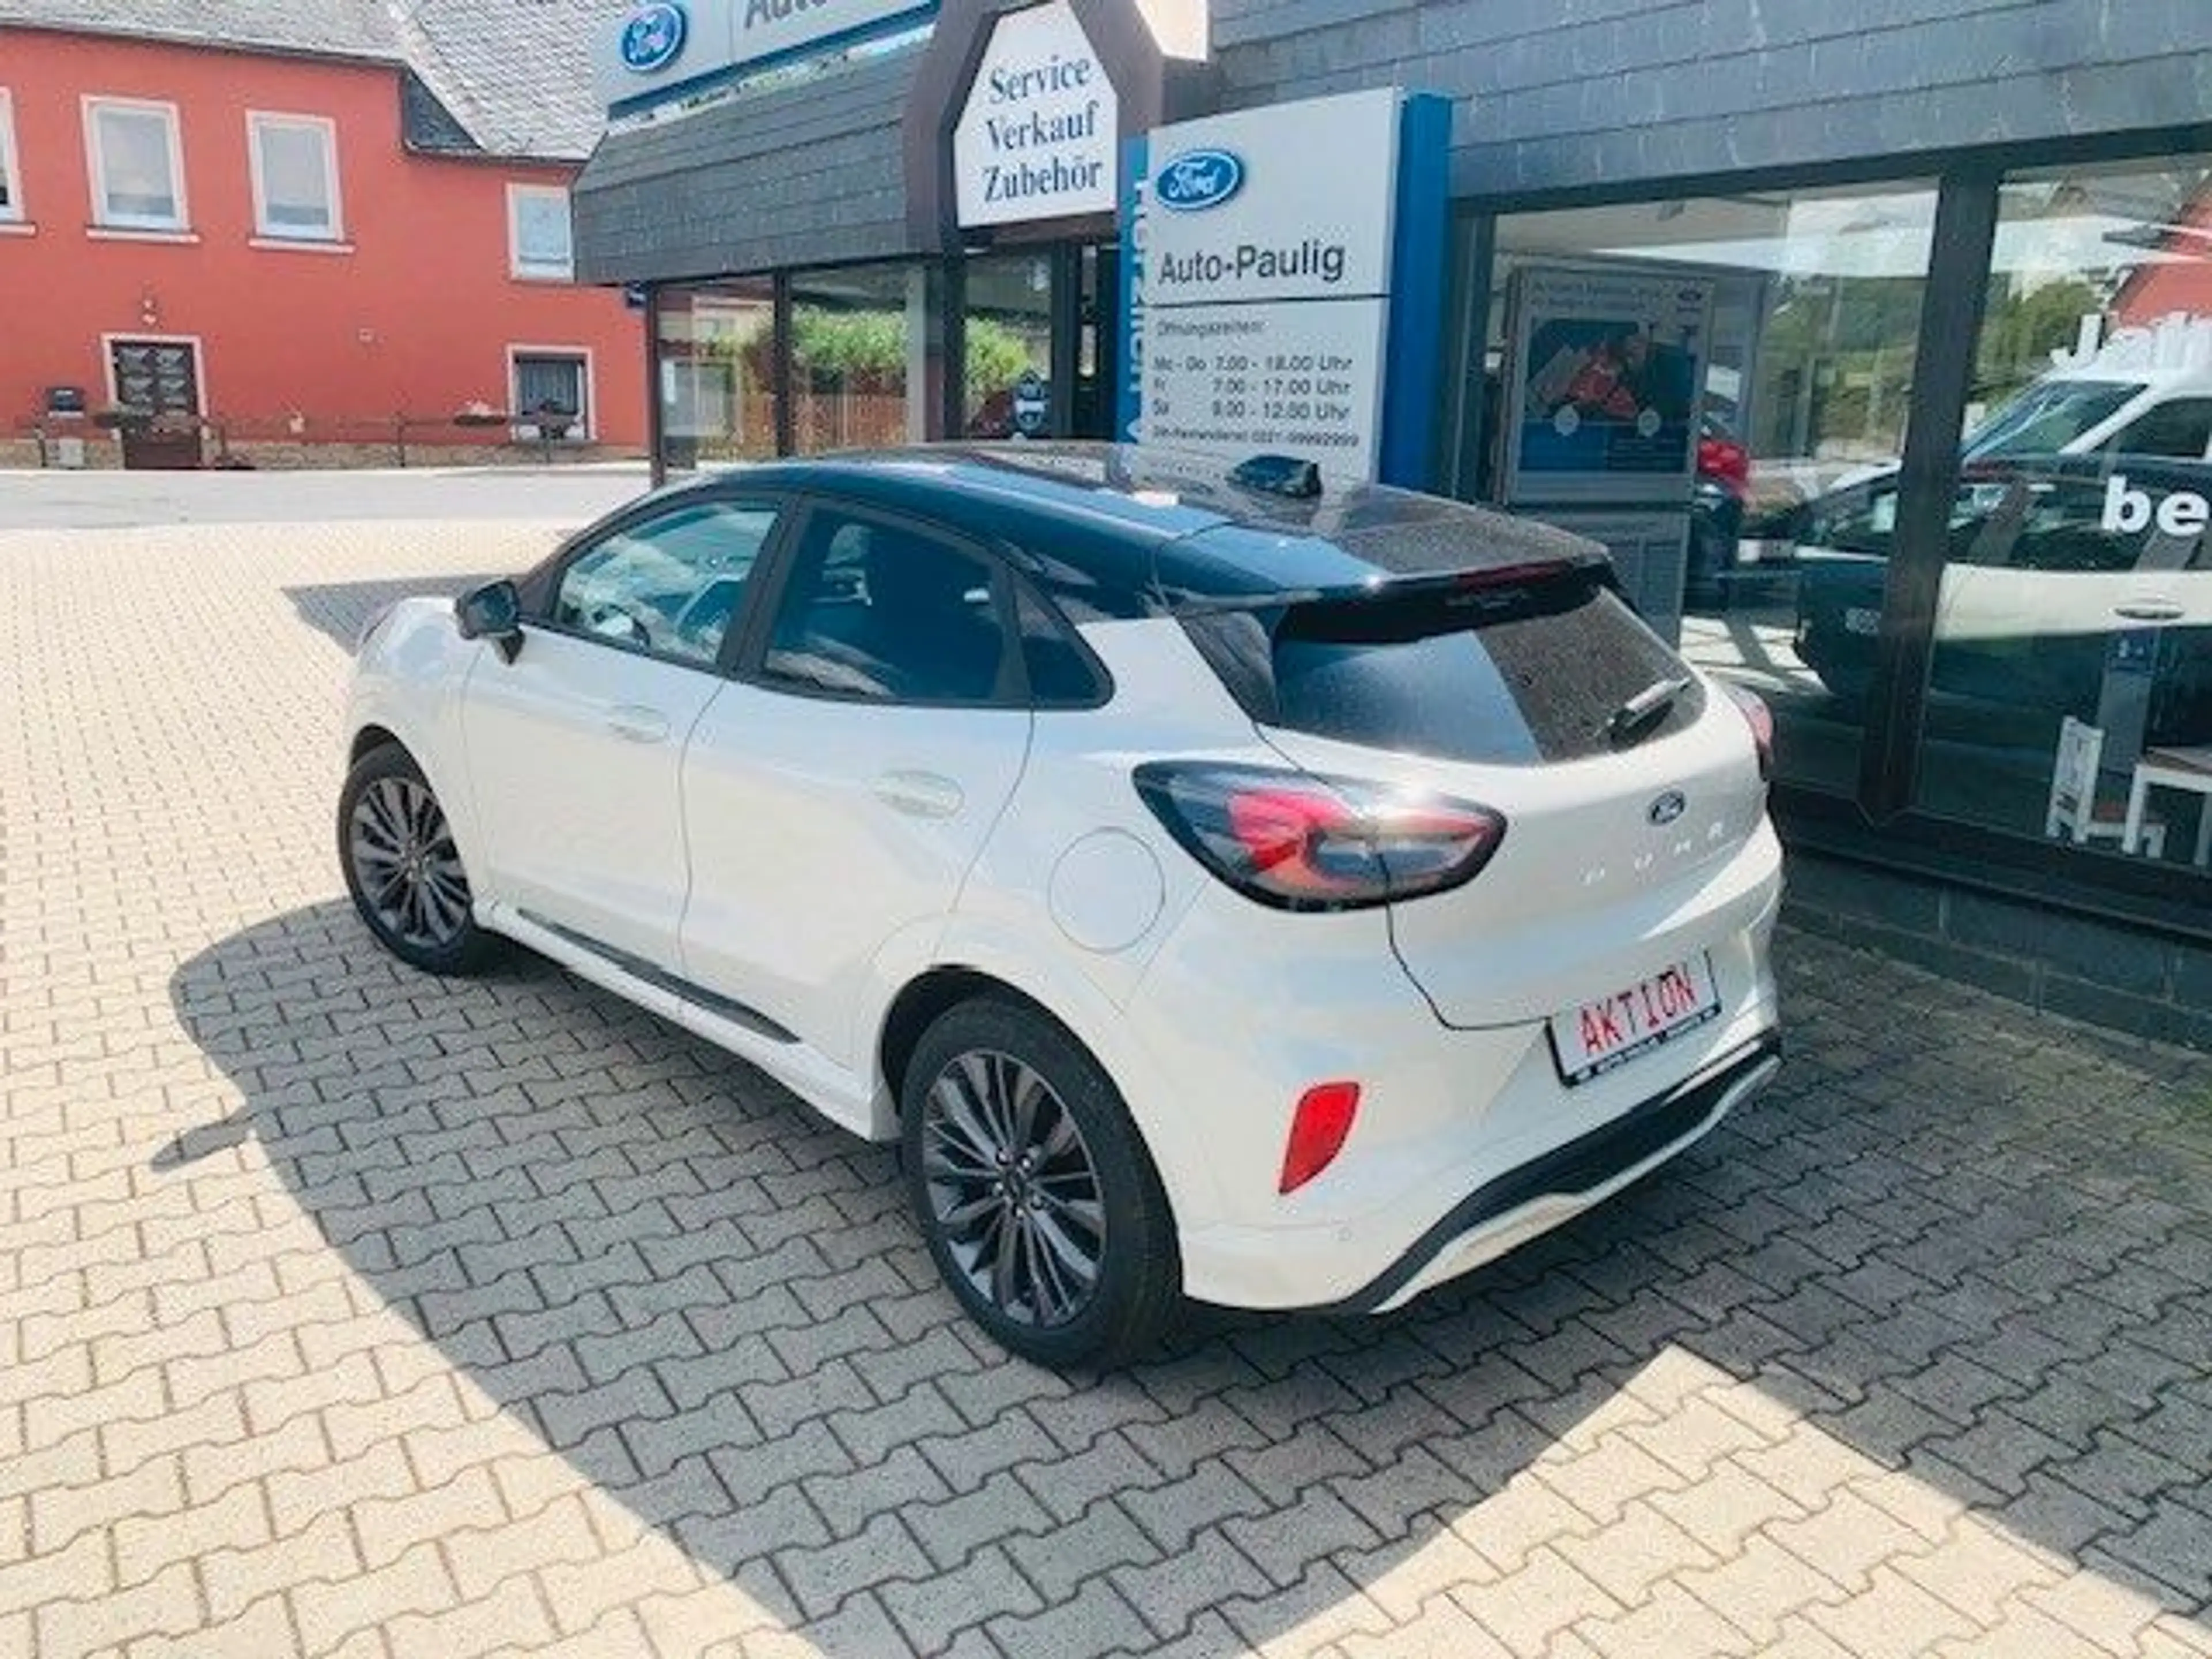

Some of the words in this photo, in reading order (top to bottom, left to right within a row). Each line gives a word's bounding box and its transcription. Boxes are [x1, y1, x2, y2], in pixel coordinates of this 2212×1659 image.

[989, 55, 1090, 105] Service
[987, 100, 1100, 151] Verkauf
[982, 155, 1103, 202] Zubehör
[1167, 158, 1221, 199] Ford
[1158, 240, 1345, 283] Auto-Paulig
[1318, 354, 1353, 371] Uhr
[1316, 377, 1352, 395] Uhr
[1315, 402, 1350, 421] Uhr
[2101, 474, 2210, 536] be
[1581, 960, 1698, 1057] AKTION
